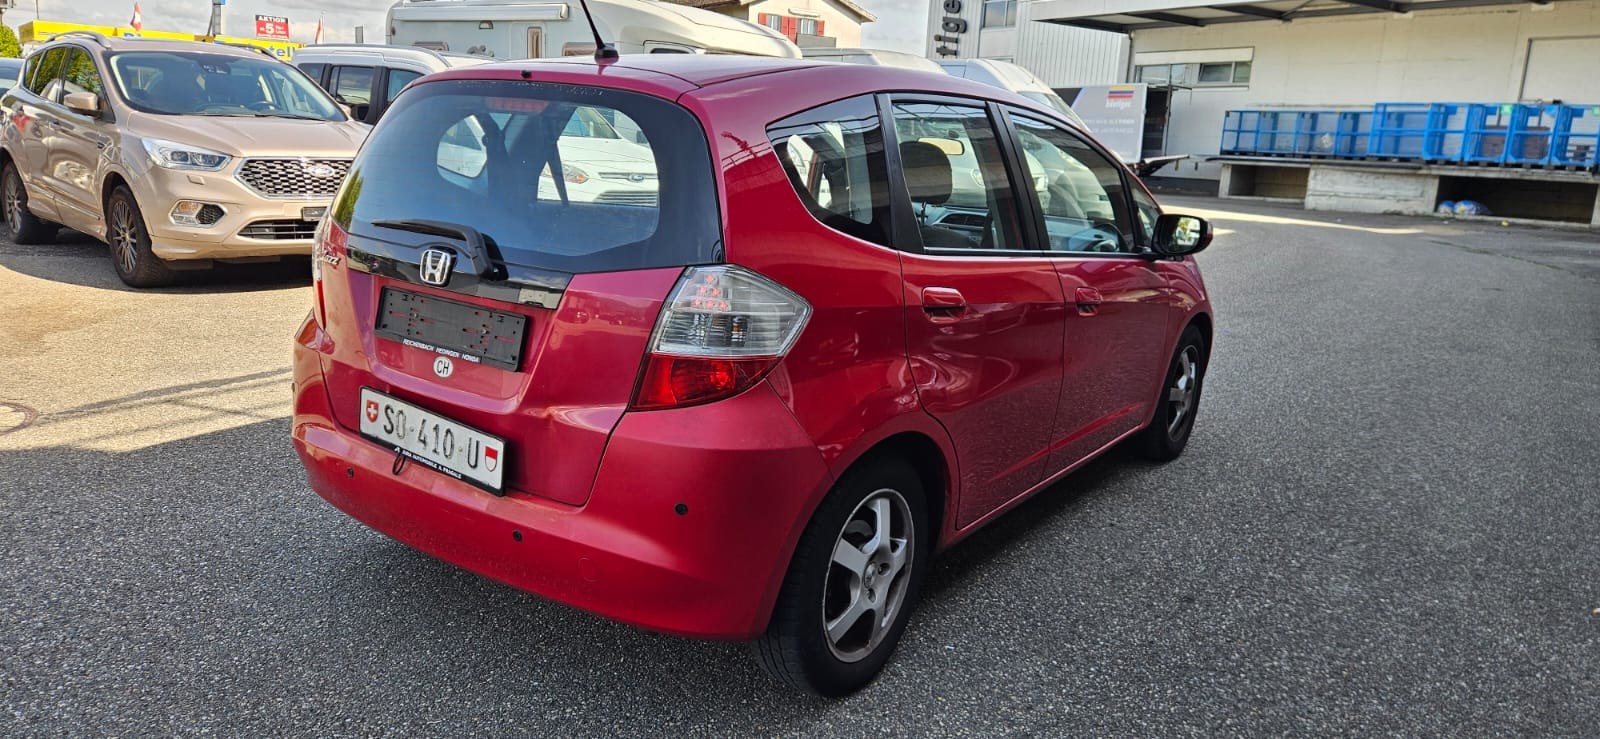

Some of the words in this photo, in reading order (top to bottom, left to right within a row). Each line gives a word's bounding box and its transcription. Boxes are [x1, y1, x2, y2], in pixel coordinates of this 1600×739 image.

[258, 15, 286, 23] AKTION
[462, 354, 479, 363] HONDA
[436, 360, 450, 375] CH
